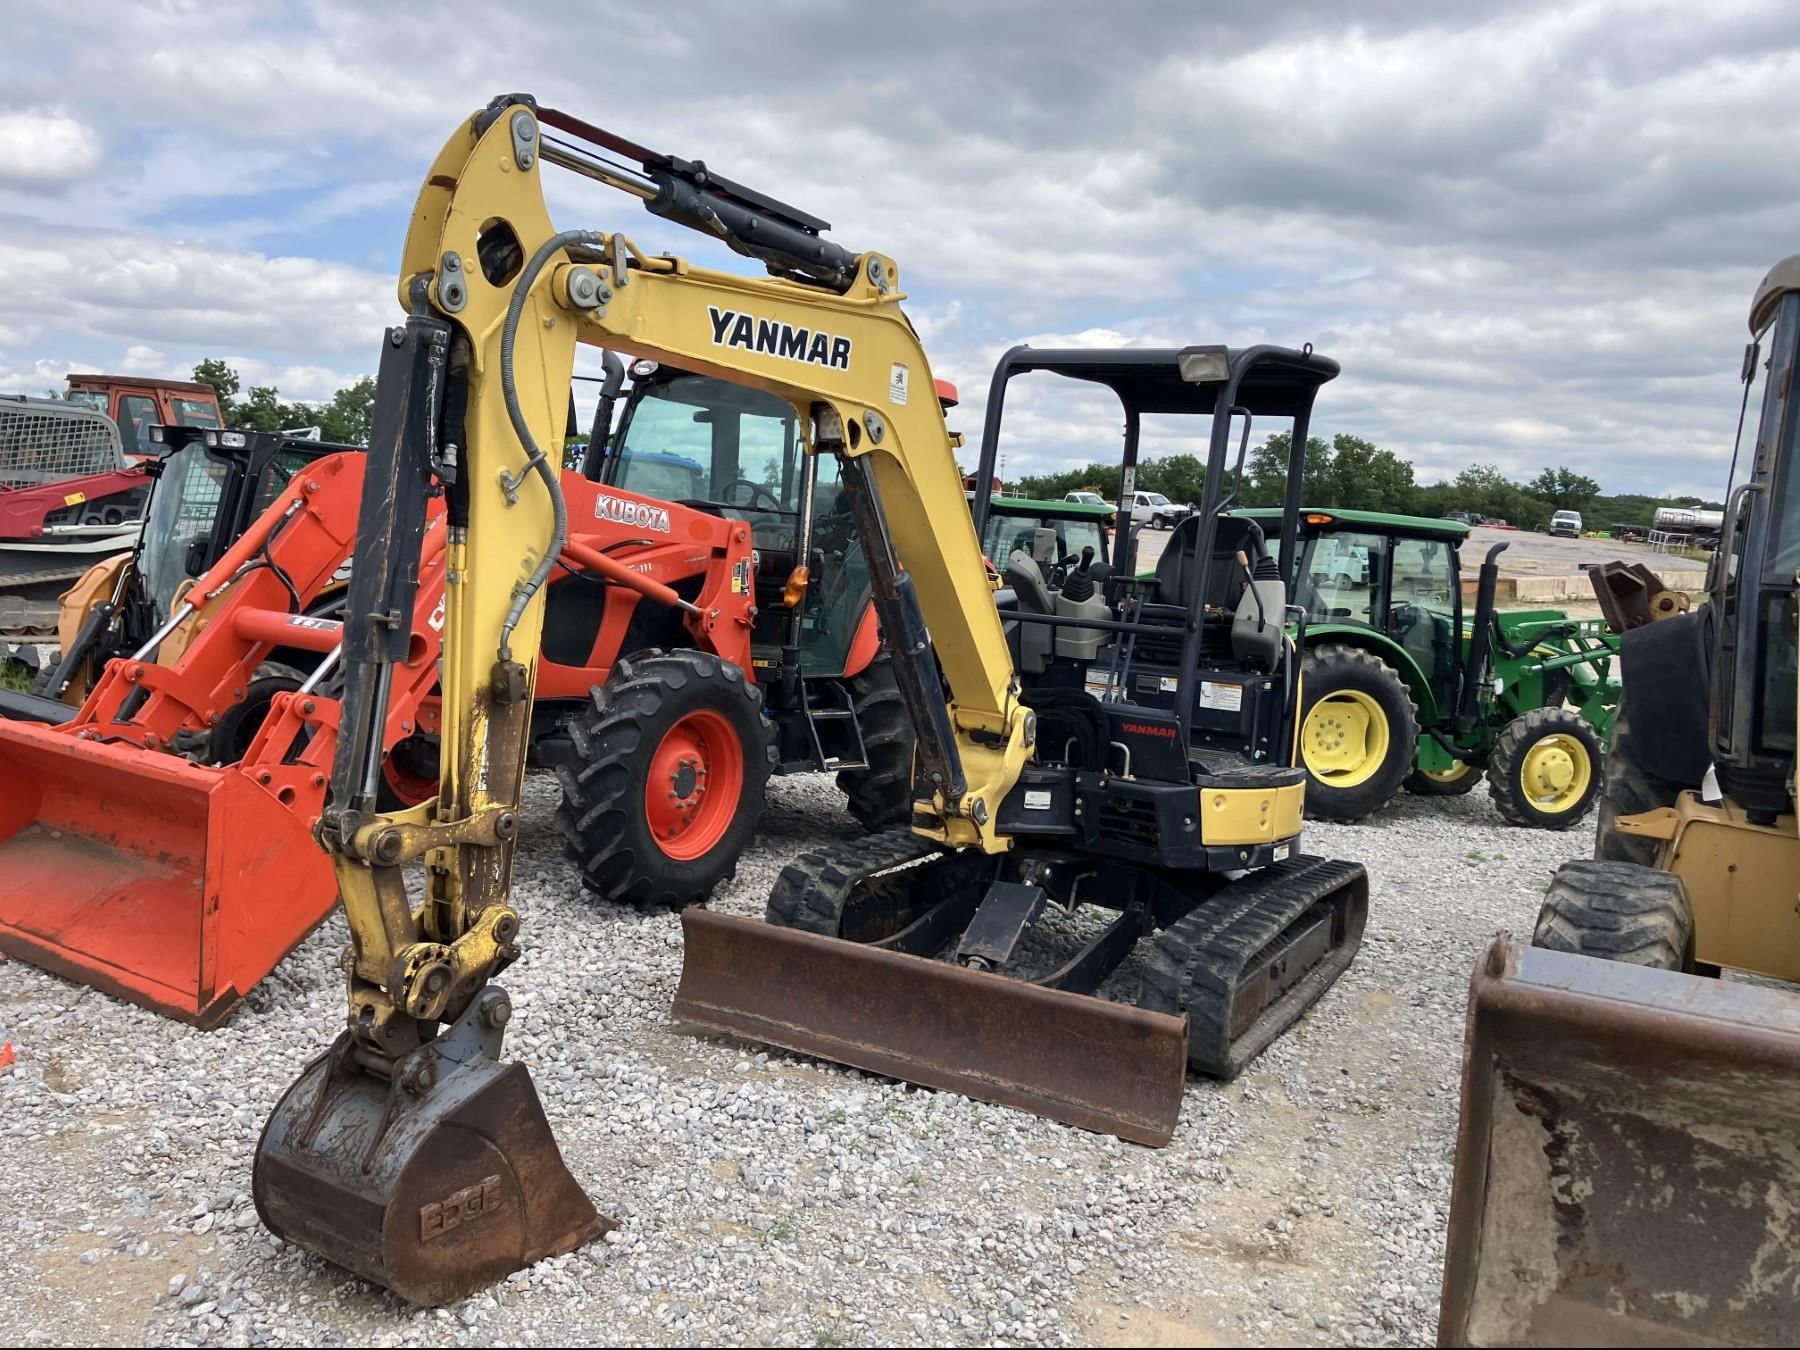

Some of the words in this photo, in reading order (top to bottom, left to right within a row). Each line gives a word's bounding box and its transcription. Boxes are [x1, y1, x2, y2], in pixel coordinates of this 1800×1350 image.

[708, 305, 852, 371] YANMAR
[595, 494, 671, 533] KUBOTA
[1121, 722, 1177, 738] YANMAR
